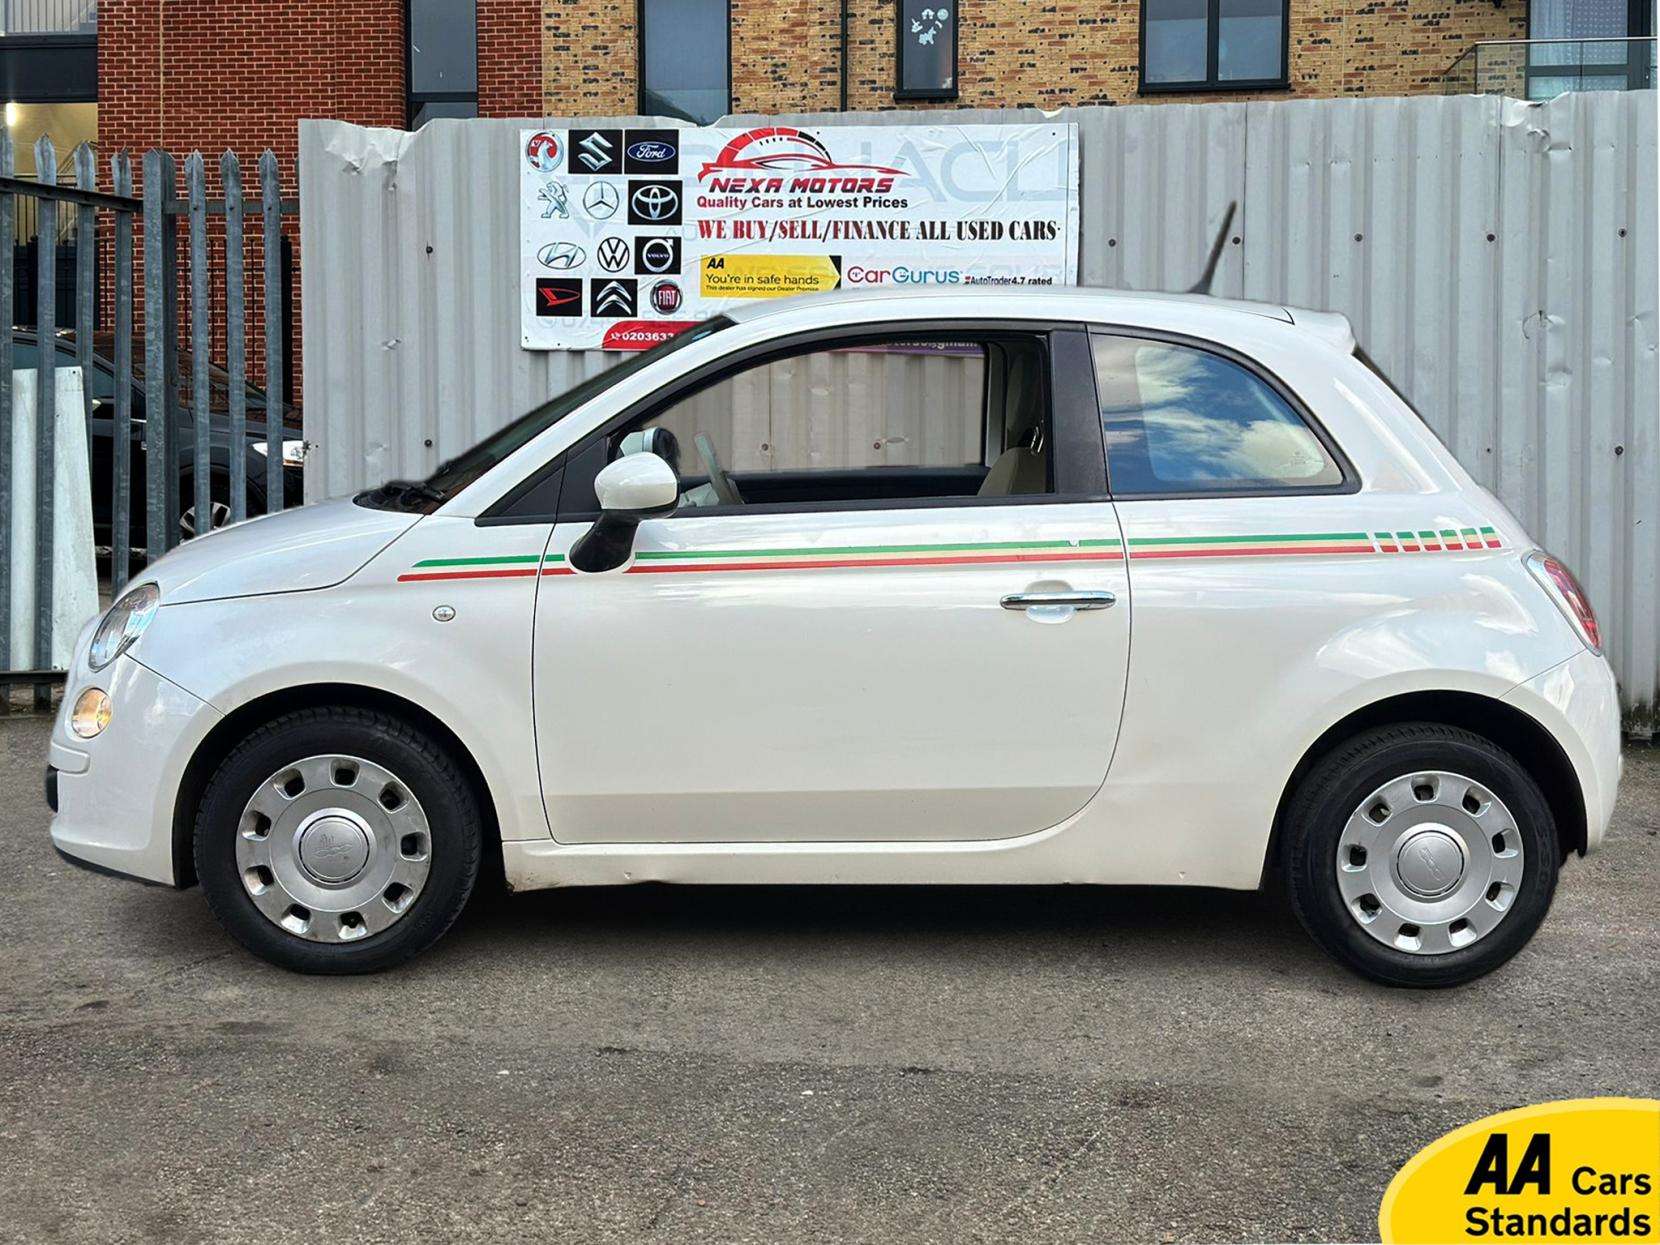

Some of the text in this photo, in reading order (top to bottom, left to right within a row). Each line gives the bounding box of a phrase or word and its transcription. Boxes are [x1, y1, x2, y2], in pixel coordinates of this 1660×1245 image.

[636, 145, 665, 158] Ford
[709, 178, 894, 193] NEXA MOTORS
[697, 196, 908, 210] Quality Cars at Lowest Prices
[698, 220, 727, 239] WE
[733, 219, 911, 242] BUY/SELL/FINANCE
[916, 220, 950, 240] ALL
[956, 220, 1004, 240] USED
[1008, 220, 1057, 240] CARS
[707, 257, 725, 269] AA
[706, 274, 820, 285] You're in safe hands
[1011, 276, 1025, 285] 4.7
[1027, 277, 1053, 286] rated
[658, 291, 675, 306] FIAT
